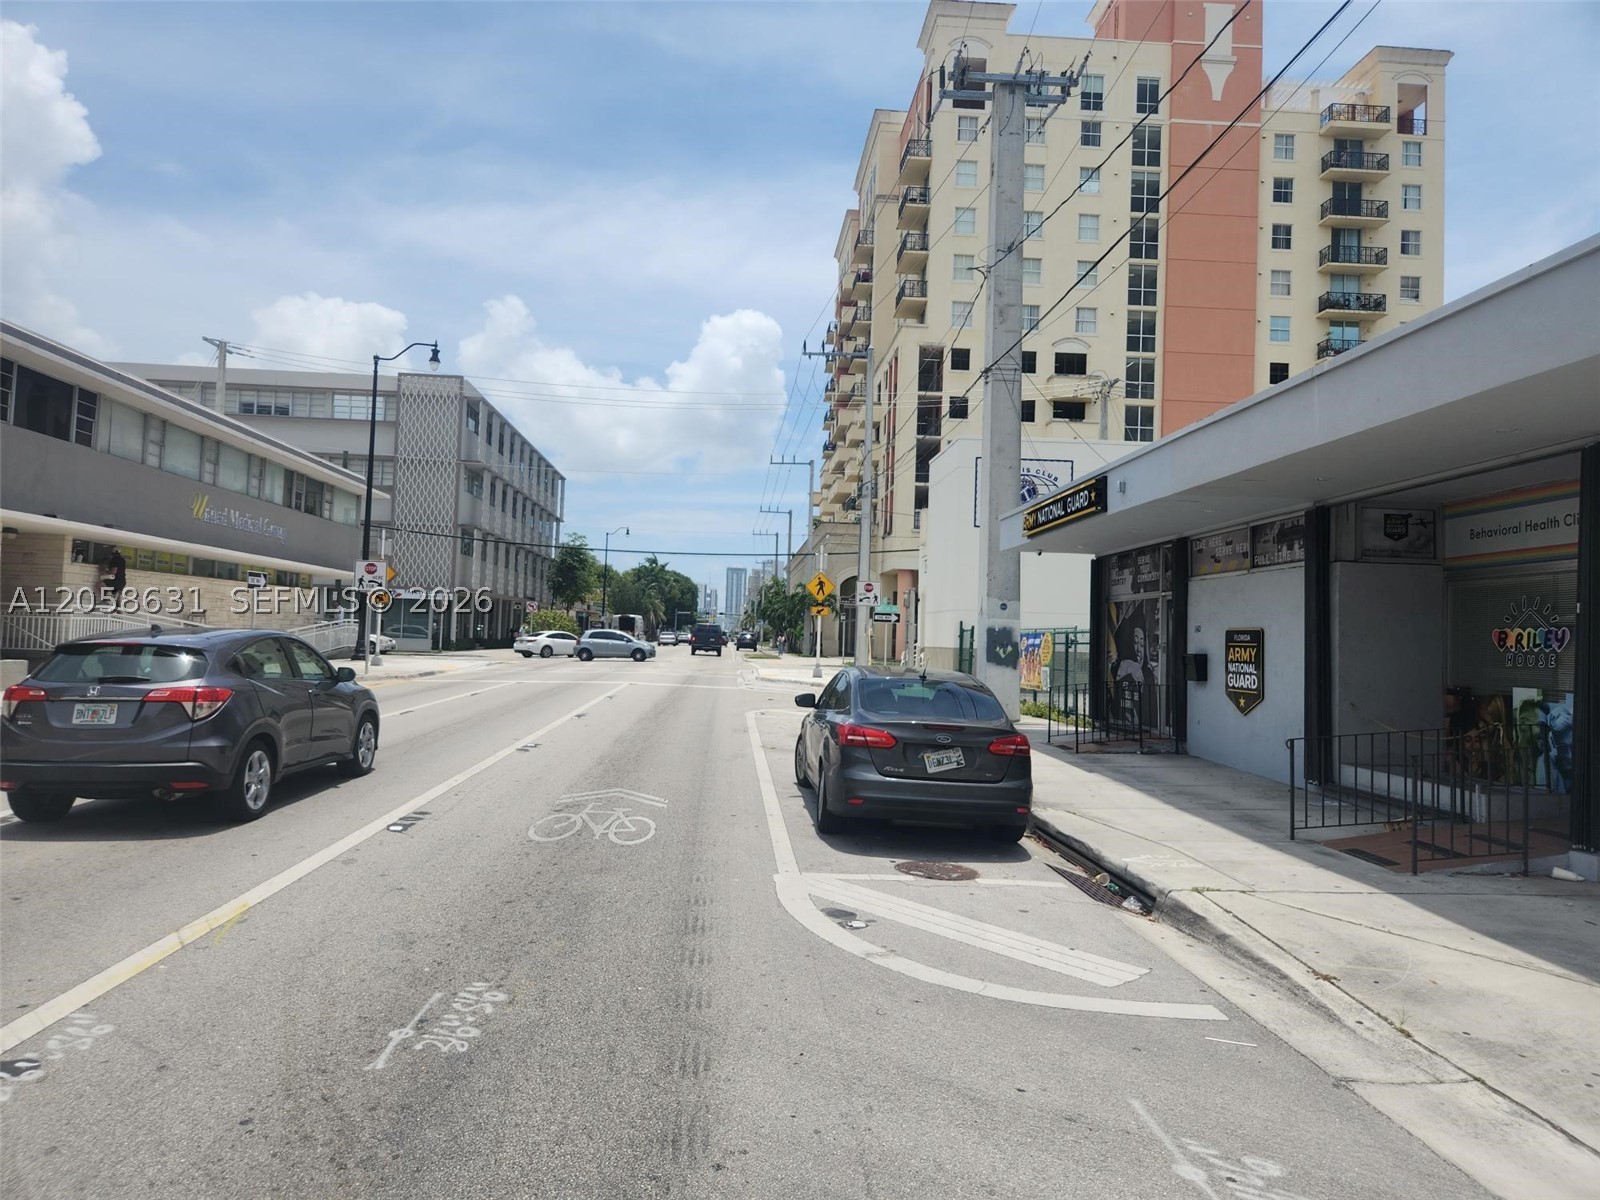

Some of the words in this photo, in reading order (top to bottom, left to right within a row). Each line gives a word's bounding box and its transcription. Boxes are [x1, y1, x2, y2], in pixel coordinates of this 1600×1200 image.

[1035, 468, 1059, 482] CLUB
[1037, 500, 1065, 525] NATIONAL
[1066, 490, 1089, 513] GUARD
[1469, 521, 1521, 540] Behavioral
[1525, 516, 1560, 533] Health
[1563, 513, 1580, 527] Cli
[1228, 647, 1257, 662] ARMY
[1506, 652, 1556, 668] HOUSE
[1227, 662, 1258, 673] NATIONAL
[1227, 673, 1258, 689] GUARD
